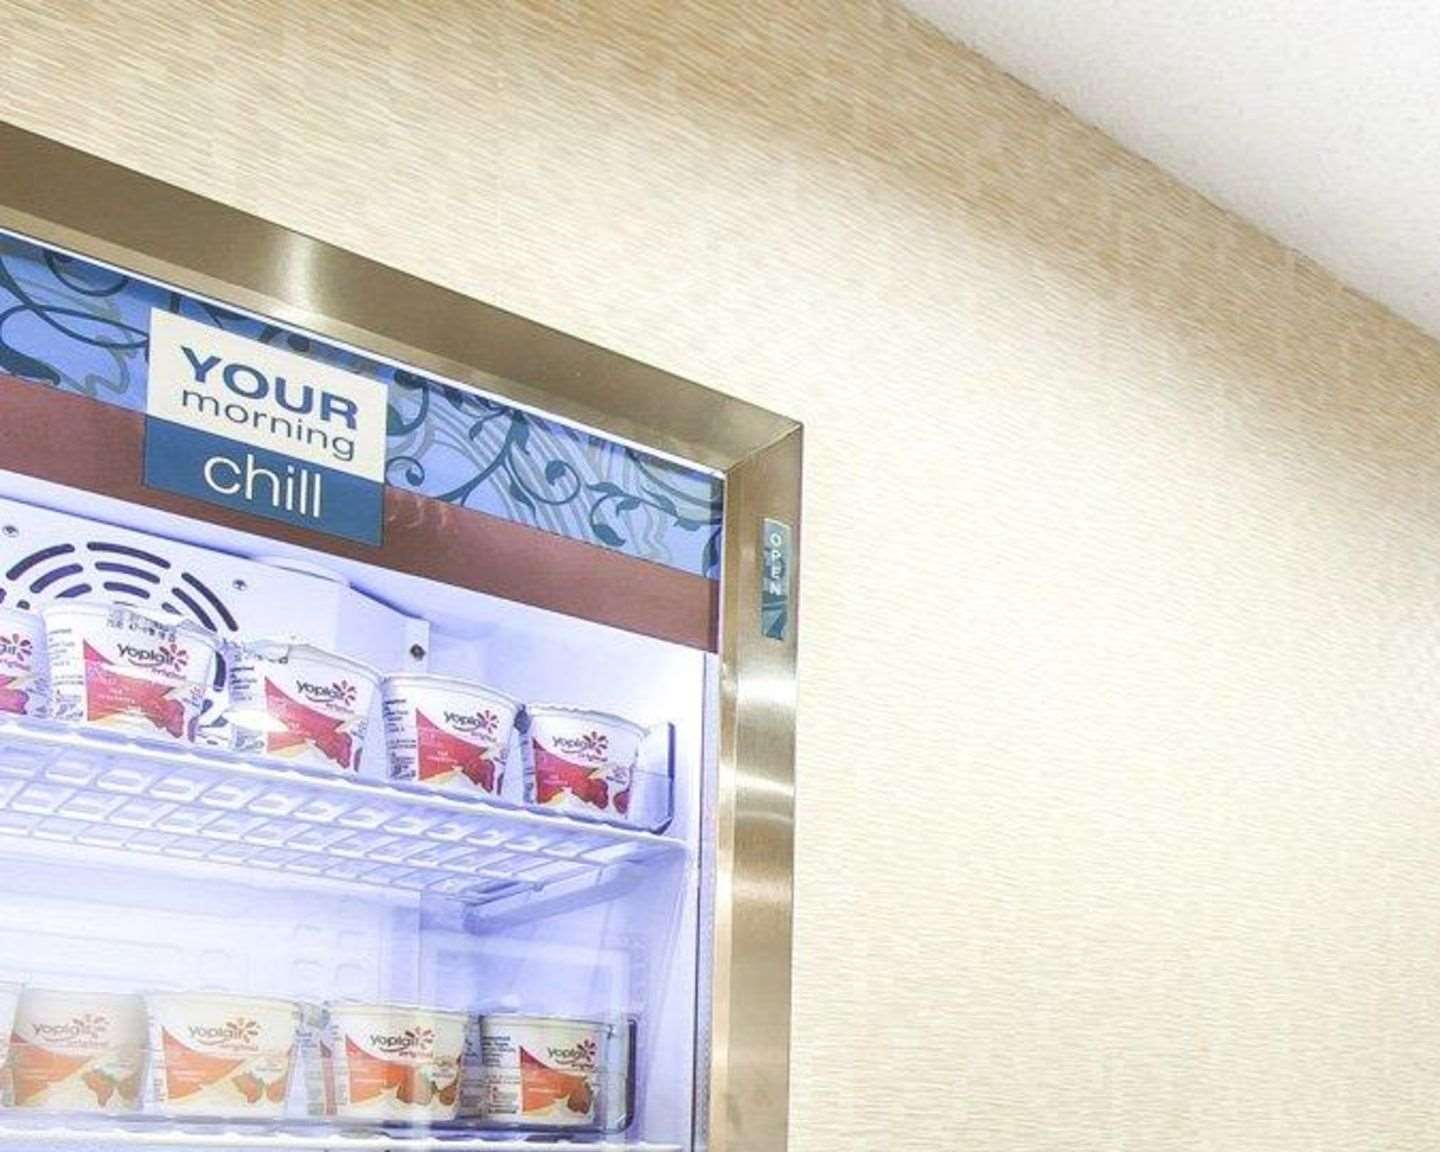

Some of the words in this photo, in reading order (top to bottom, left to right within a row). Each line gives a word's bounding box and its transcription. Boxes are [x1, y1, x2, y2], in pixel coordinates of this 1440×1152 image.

[180, 346, 358, 430] YOUR
[182, 388, 355, 462] morning
[204, 454, 321, 518] chill
[769, 532, 782, 596] OPEN
